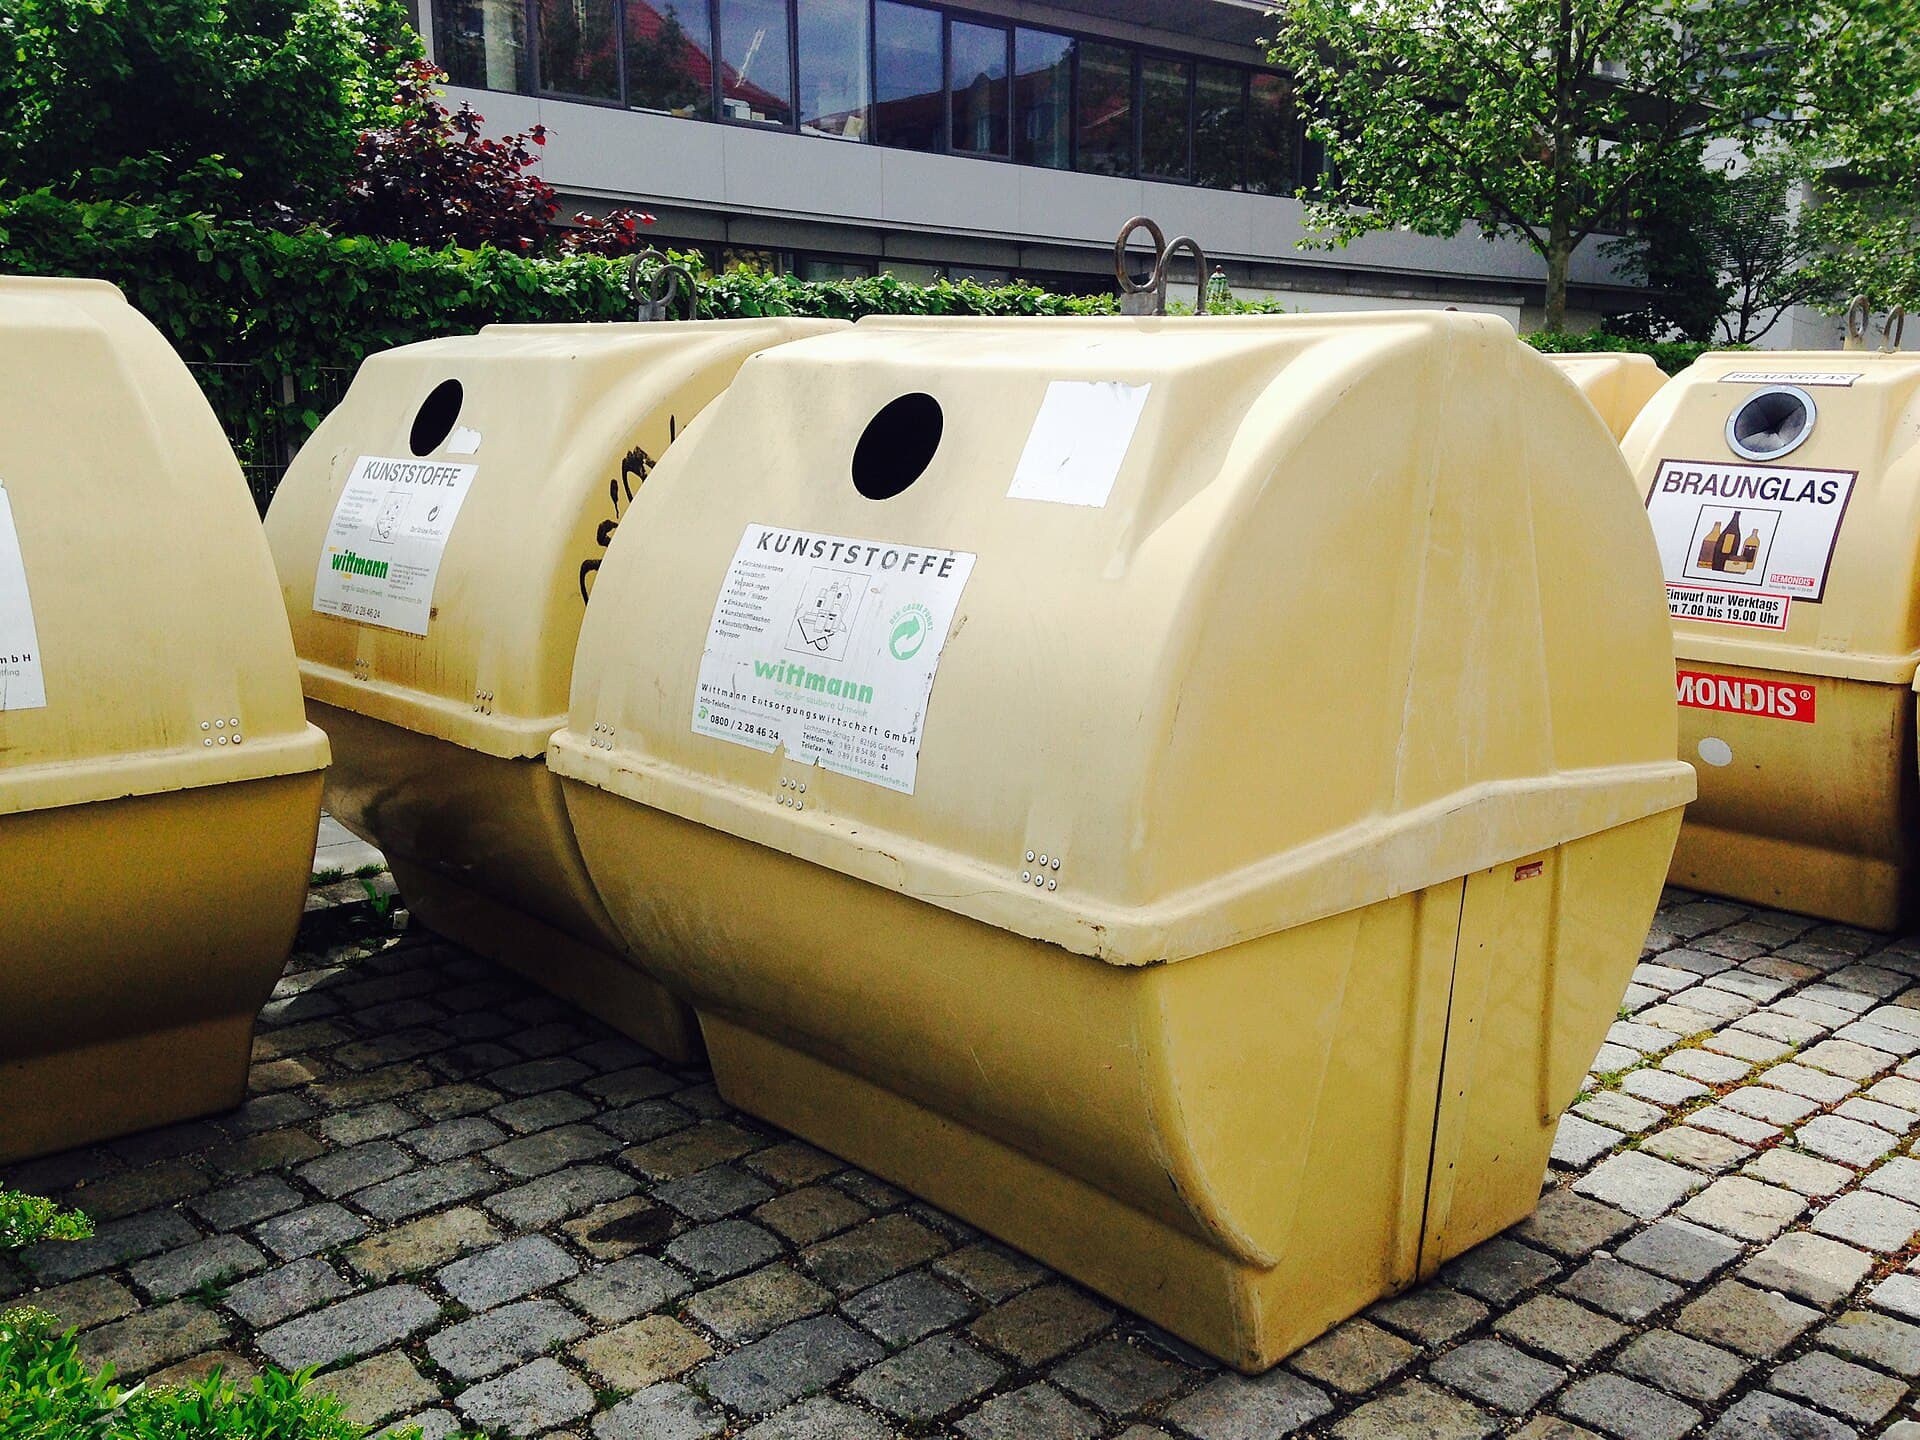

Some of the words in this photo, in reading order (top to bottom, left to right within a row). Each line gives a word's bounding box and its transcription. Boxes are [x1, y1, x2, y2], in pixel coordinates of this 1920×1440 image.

[362, 461, 461, 487] KUNSTSTOFFE
[1662, 470, 1839, 505] BRAUNGLAS
[332, 550, 389, 579] wittmann
[757, 532, 956, 578] KUNSTSTOFFE
[1681, 603, 1704, 616] 7.00
[1707, 605, 1723, 618] bis
[1726, 608, 1756, 622] 19.00
[1759, 612, 1780, 625] Uhr
[1706, 593, 1725, 605] nur
[1727, 594, 1779, 612] Werktags
[754, 658, 874, 704] wittmann
[700, 696, 730, 710] Info-Telefon
[701, 683, 747, 701] Wittmann
[752, 696, 878, 736] Entsorgungswirtschaft
[884, 730, 916, 745] GmbH
[710, 714, 729, 727] 0800
[737, 721, 743, 731] 2
[744, 723, 755, 734] 28
[756, 726, 767, 737] 46
[768, 729, 779, 740] 24
